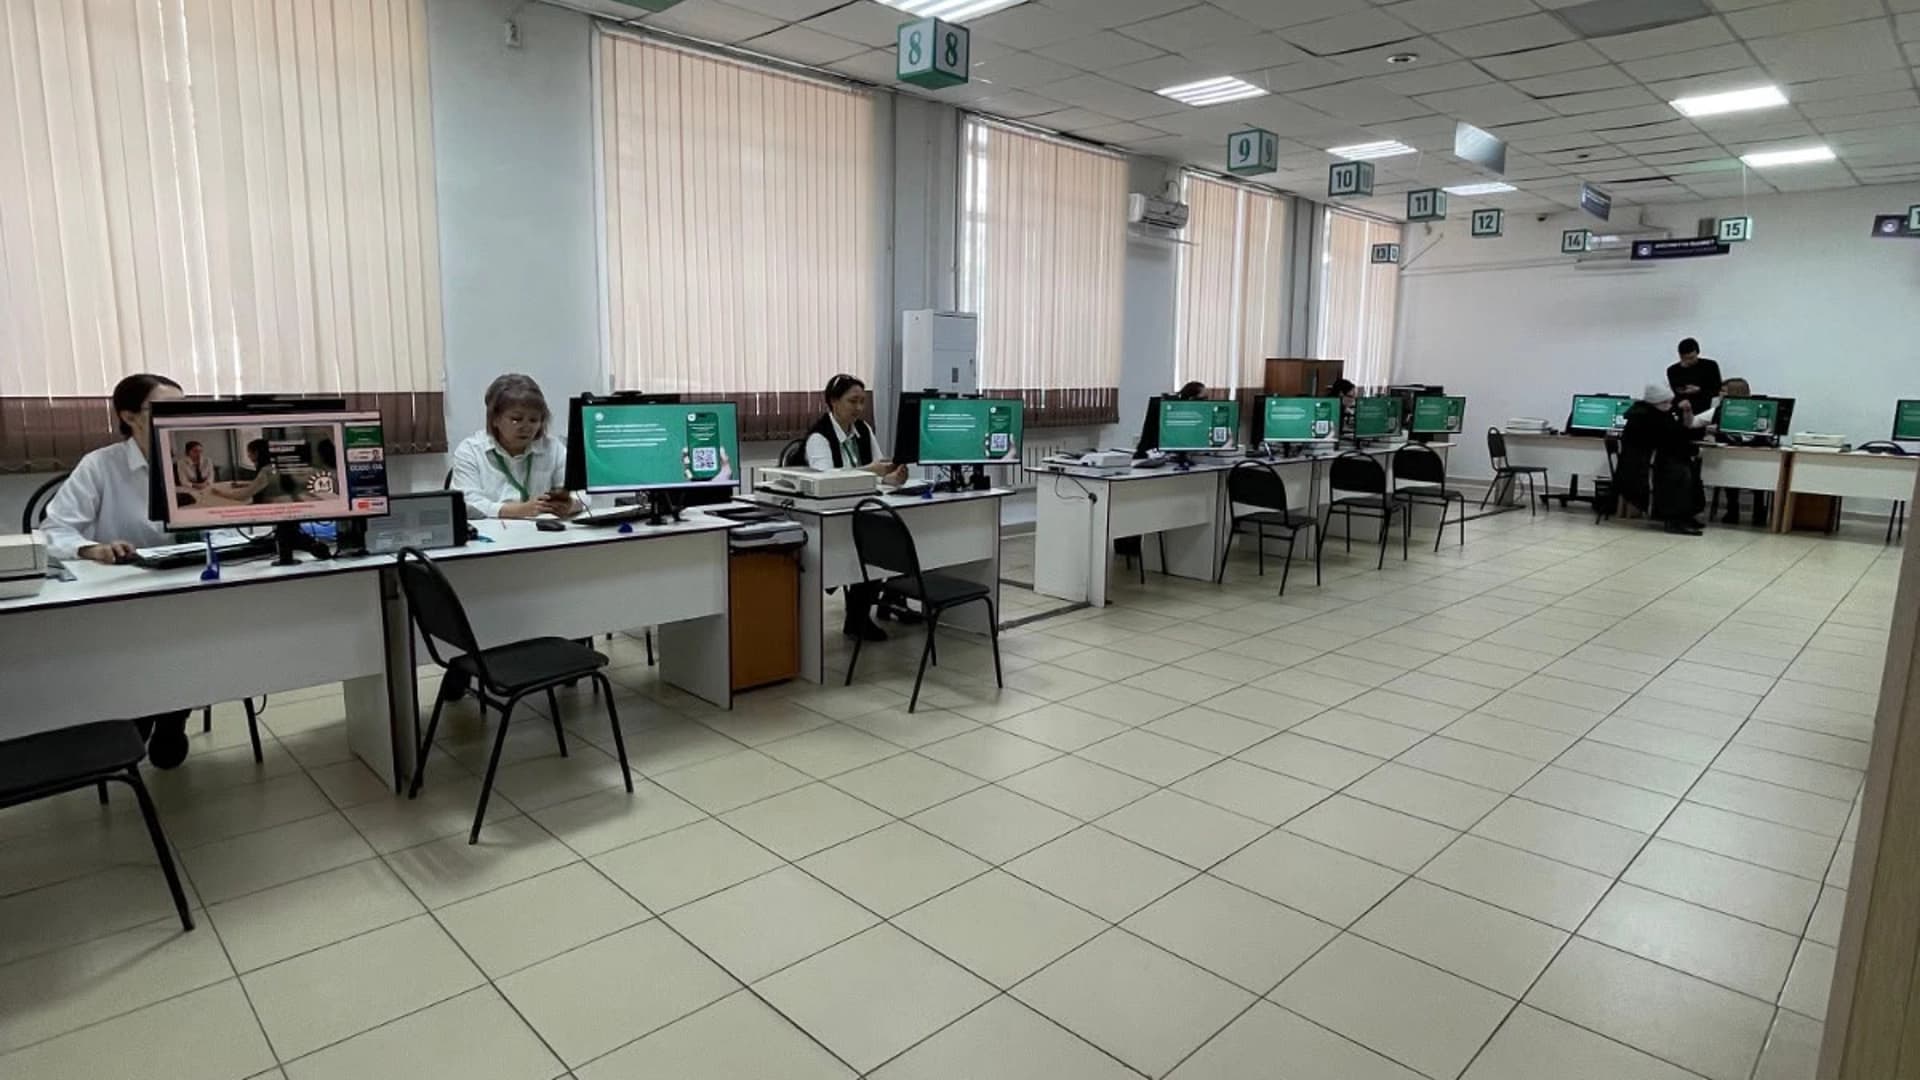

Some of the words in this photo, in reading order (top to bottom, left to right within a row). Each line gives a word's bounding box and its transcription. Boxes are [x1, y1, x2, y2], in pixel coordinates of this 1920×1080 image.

[909, 31, 921, 66] 8
[945, 32, 959, 68] 8
[1239, 138, 1250, 163] 9
[1335, 169, 1353, 189] 10
[1415, 195, 1428, 213] 11
[1478, 214, 1494, 230] 12
[1725, 222, 1741, 237] 15
[1567, 234, 1581, 248] 14
